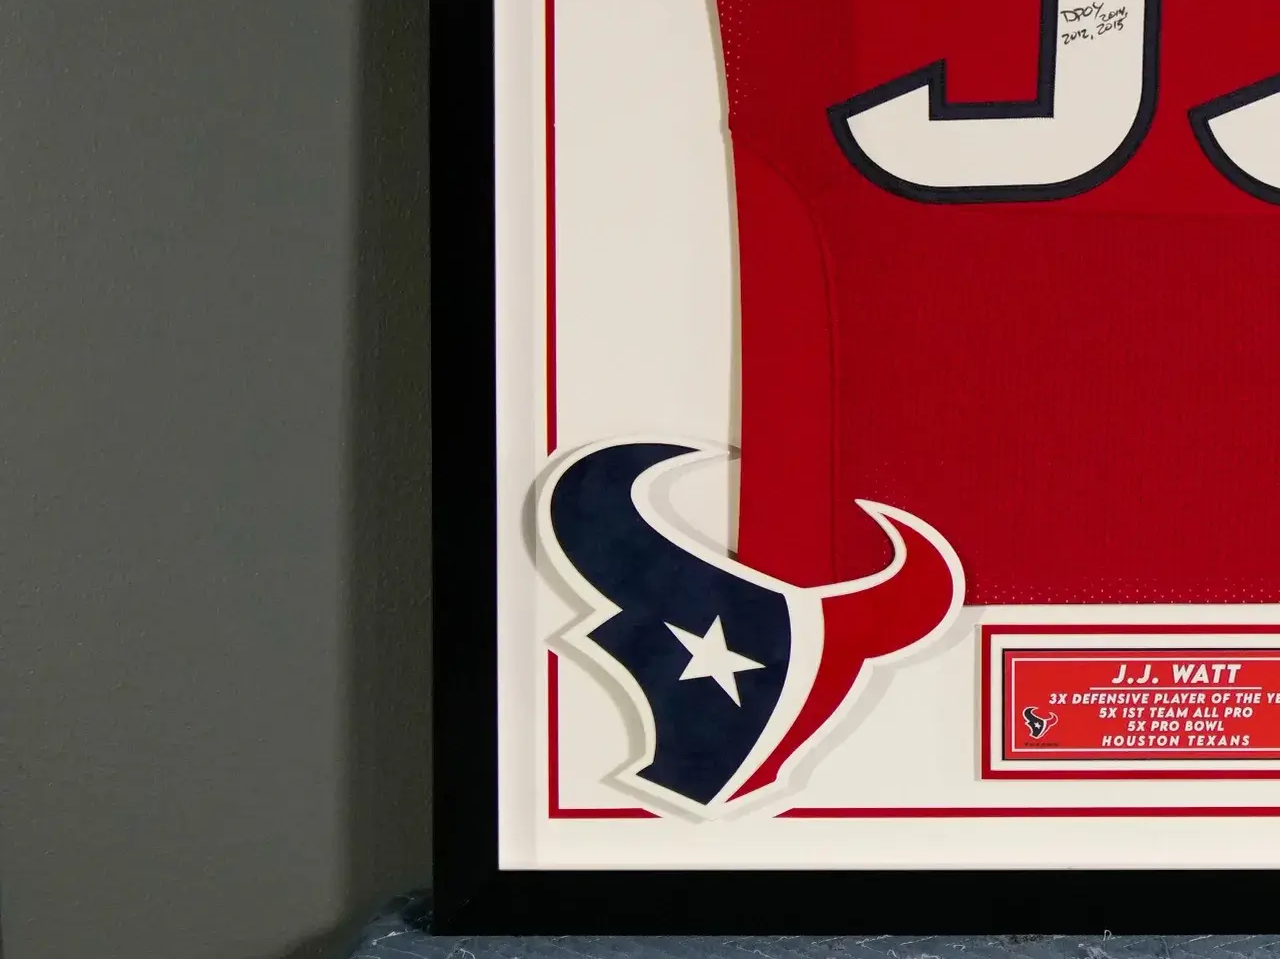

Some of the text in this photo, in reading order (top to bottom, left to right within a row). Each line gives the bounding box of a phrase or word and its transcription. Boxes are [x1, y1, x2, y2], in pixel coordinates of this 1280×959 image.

[1060, 2, 1104, 22] DPOY
[1111, 663, 1242, 685] J.J. WATT
[1048, 693, 1068, 705] 3X
[1071, 693, 1150, 705] DEFENSIVE
[1153, 692, 1206, 704] PLAYER
[1211, 692, 1231, 704] OF
[1235, 692, 1262, 704] THE
[1099, 706, 1253, 719] 5X 1ST TEAM ALL PRO
[1127, 720, 1225, 732] 5X PRO BOWL
[1101, 734, 1251, 747] HOUSTON TEXANS
